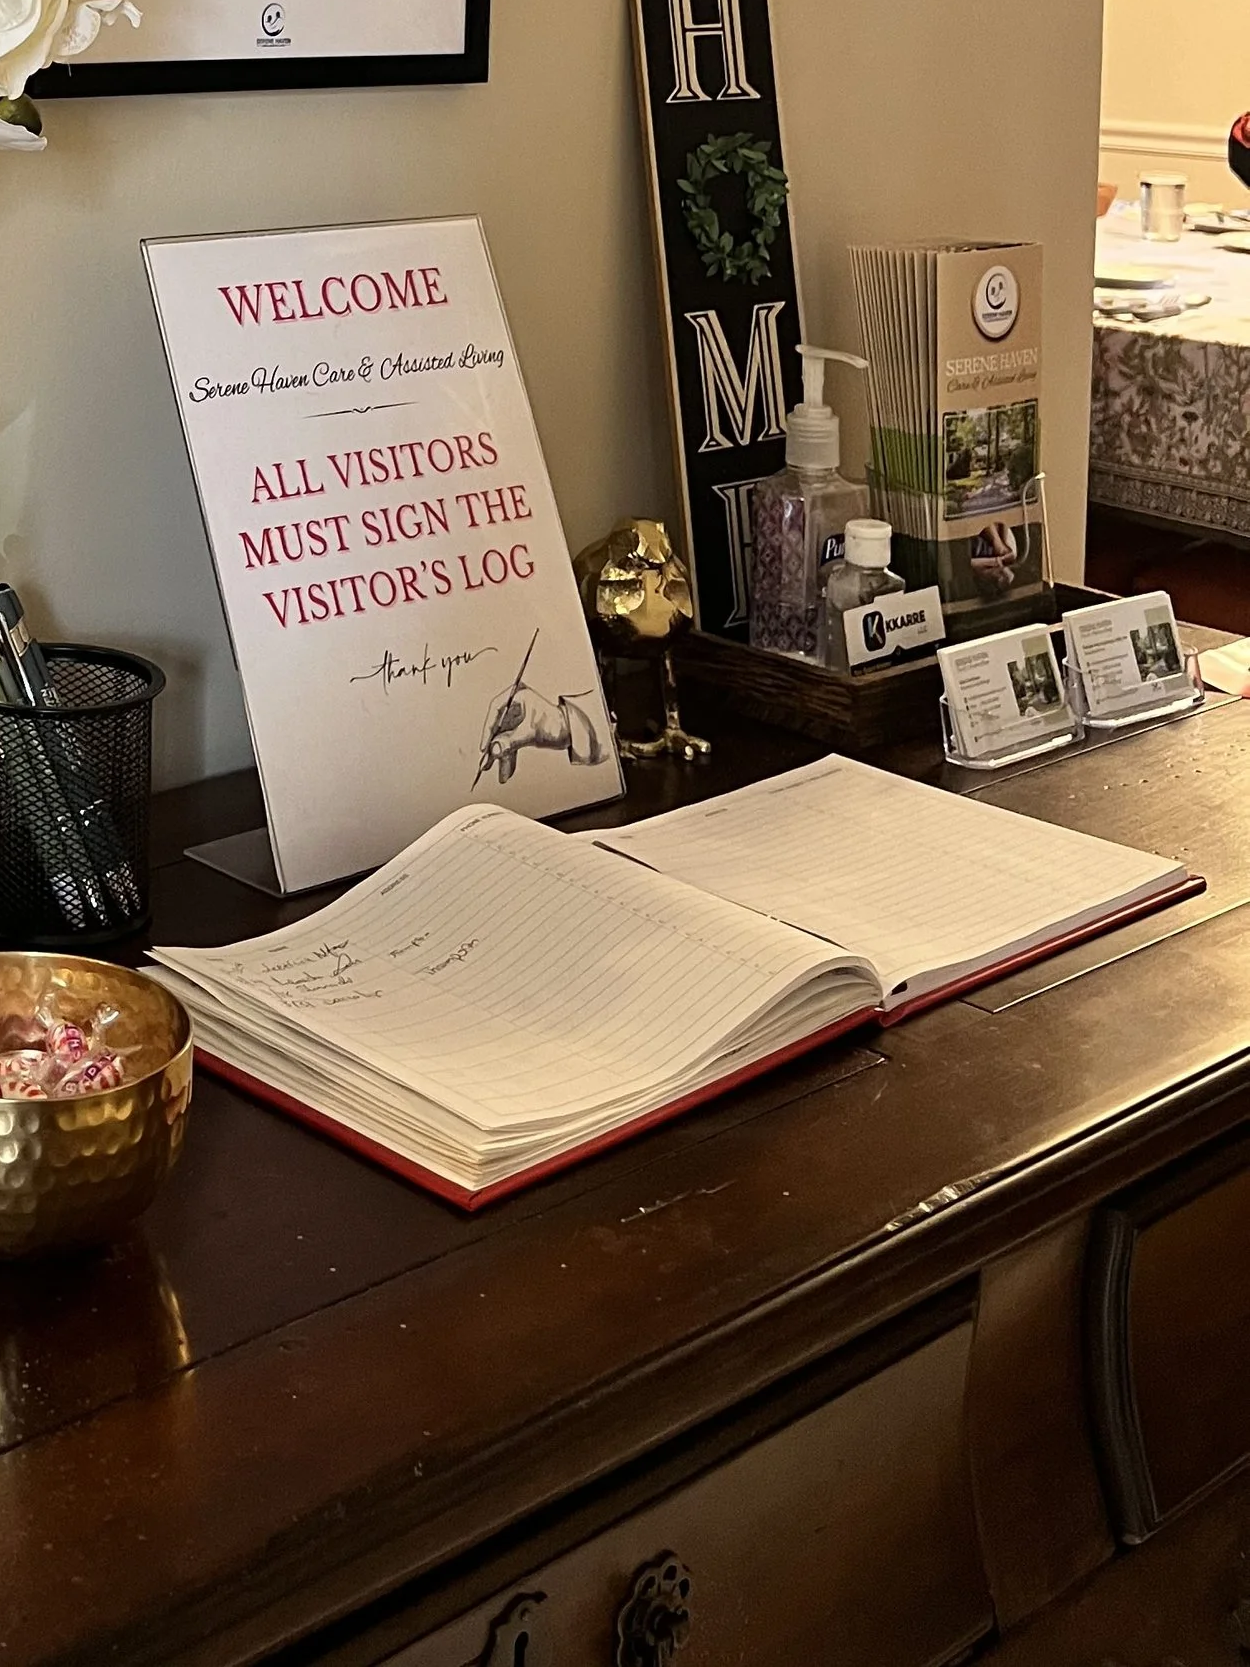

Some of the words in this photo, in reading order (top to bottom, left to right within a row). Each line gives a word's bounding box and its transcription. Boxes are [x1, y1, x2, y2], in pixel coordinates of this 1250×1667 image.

[218, 267, 448, 327] WELCOME
[189, 377, 250, 403] Serene
[251, 364, 310, 394] Haven
[312, 361, 356, 387] Care
[358, 356, 374, 383] &
[380, 351, 456, 380] Assisted
[458, 342, 505, 370] Living
[945, 353, 999, 378] SERENE
[999, 347, 1039, 371] HAVEN
[251, 459, 326, 504] ALL
[327, 431, 499, 489] VISITORS
[239, 514, 352, 569] MUST
[361, 497, 452, 548] SIGN
[455, 483, 534, 529] THE
[262, 559, 453, 629] VISITOR’S
[458, 543, 536, 591] LOG
[886, 610, 926, 634] KKARRE
[350, 642, 437, 696] thank
[440, 646, 499, 688] you
